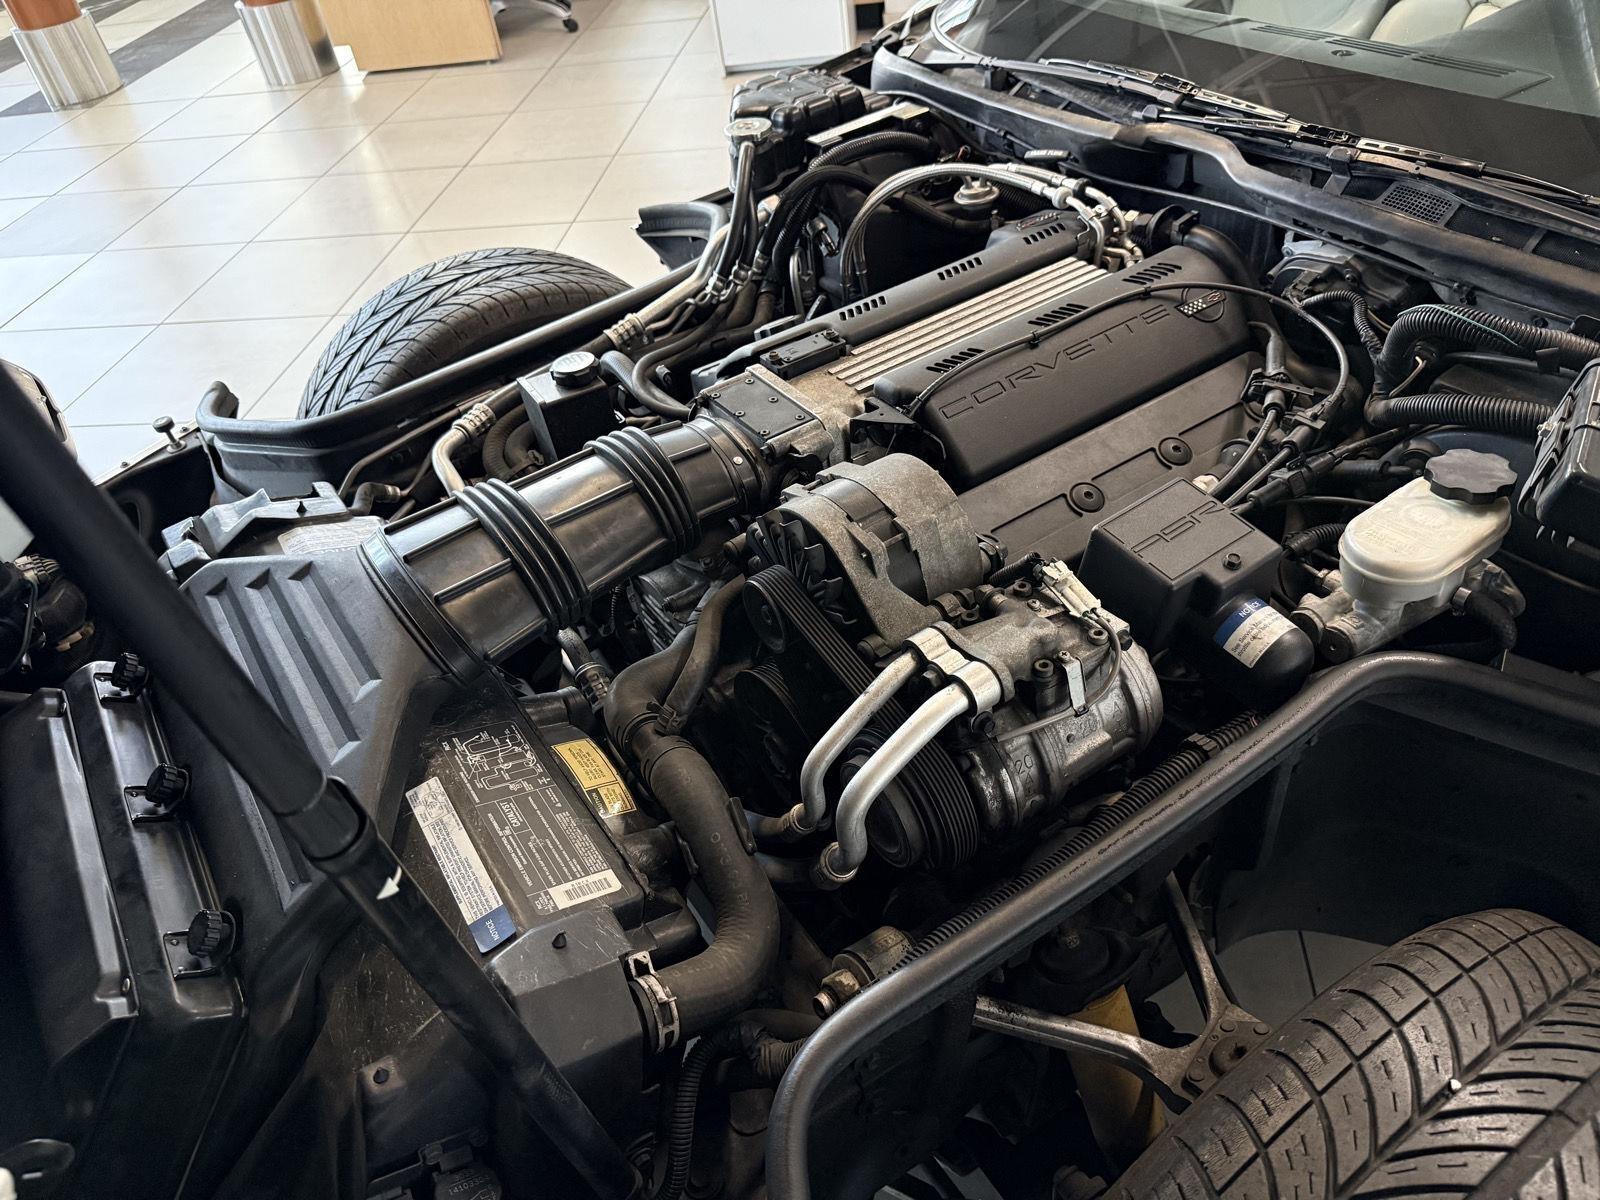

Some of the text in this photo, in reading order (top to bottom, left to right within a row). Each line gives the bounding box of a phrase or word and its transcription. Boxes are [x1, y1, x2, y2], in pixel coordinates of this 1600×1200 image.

[938, 304, 1170, 419] CORVETTE
[1238, 599, 1260, 618] NOTICE
[486, 812, 504, 836] INFORMATION
[499, 800, 521, 827] CATALYST
[500, 835, 514, 853] CONTROL
[520, 869, 533, 886] VEHICLE
[483, 917, 502, 941] NOTICE
